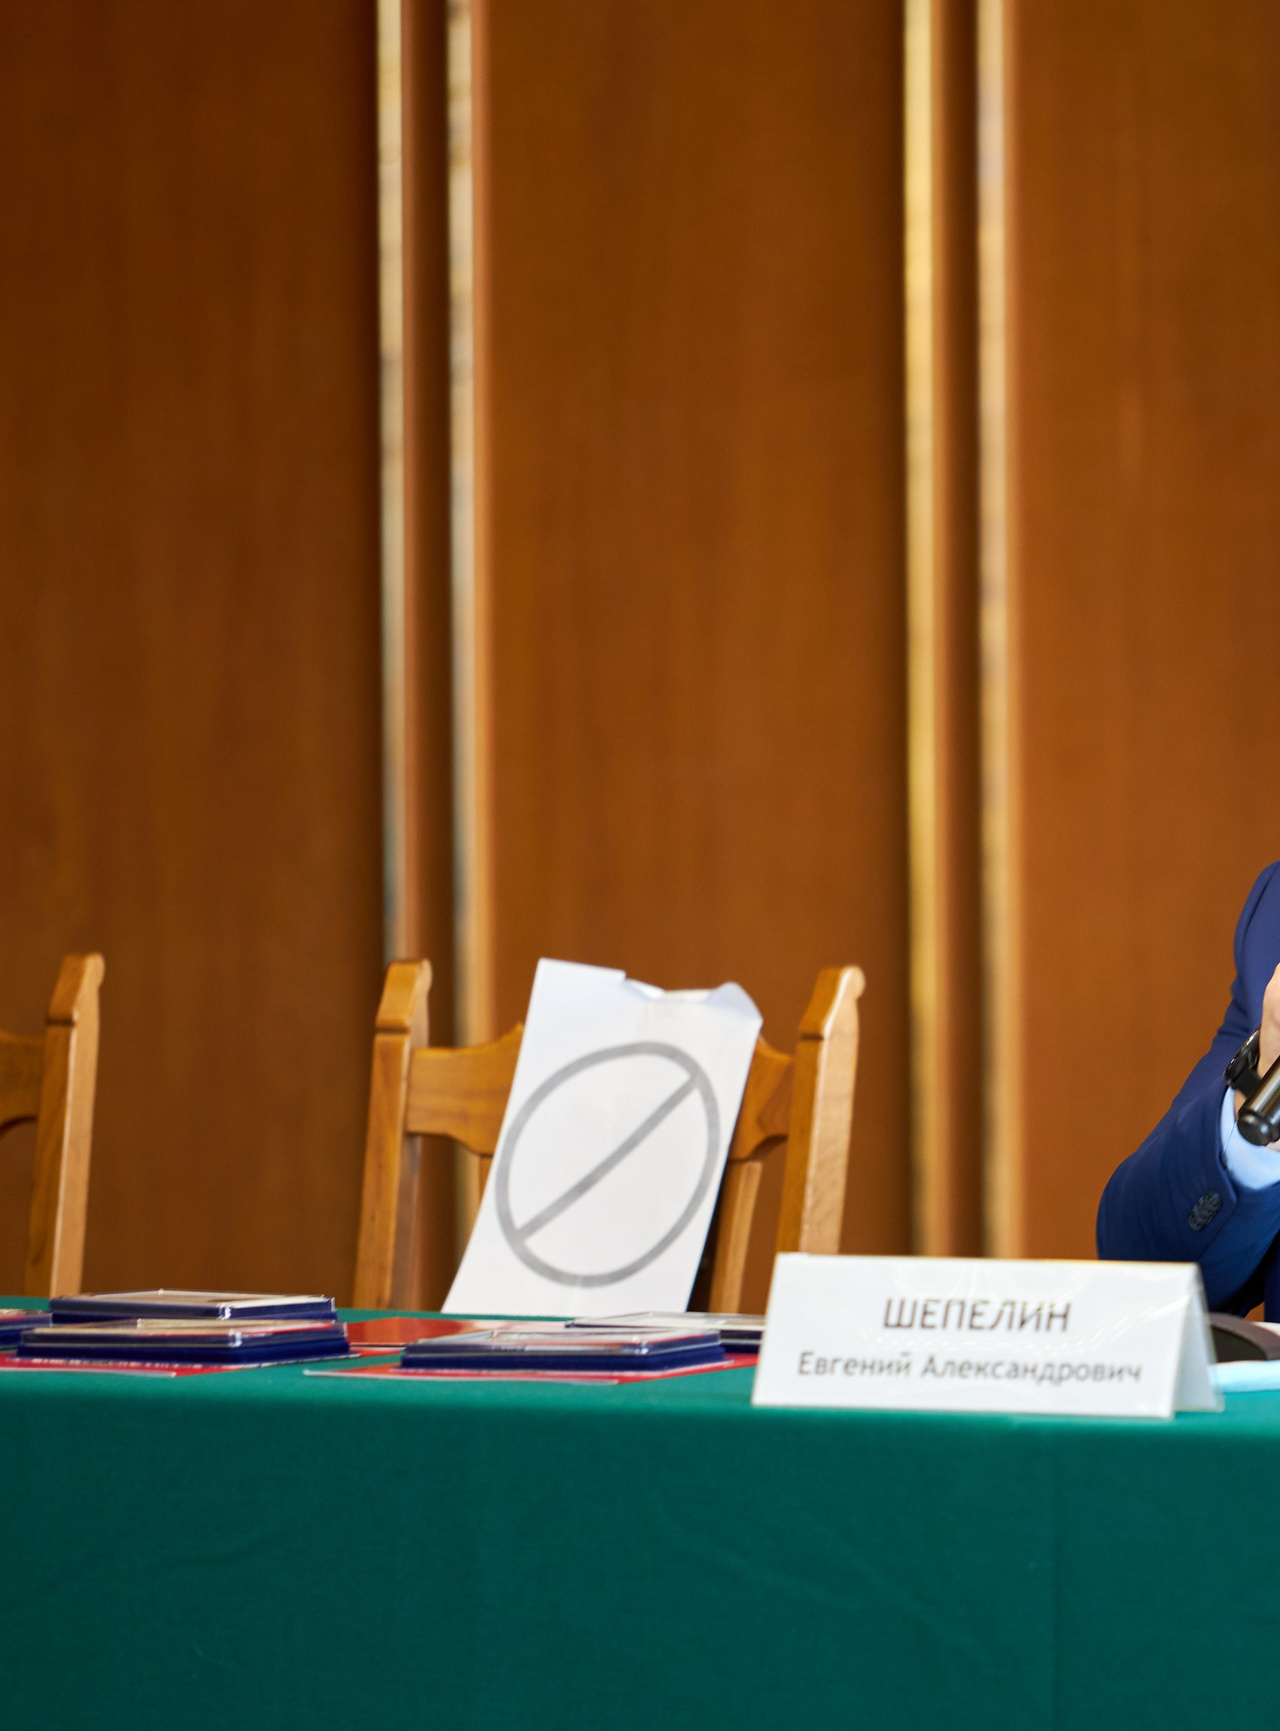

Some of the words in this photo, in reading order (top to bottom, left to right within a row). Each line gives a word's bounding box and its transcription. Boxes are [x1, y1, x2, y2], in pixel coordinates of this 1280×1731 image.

[882, 1298, 1072, 1332] ШЕПЕЛИН
[797, 1350, 912, 1378] Евгений
[920, 1353, 1142, 1385] Александрович
